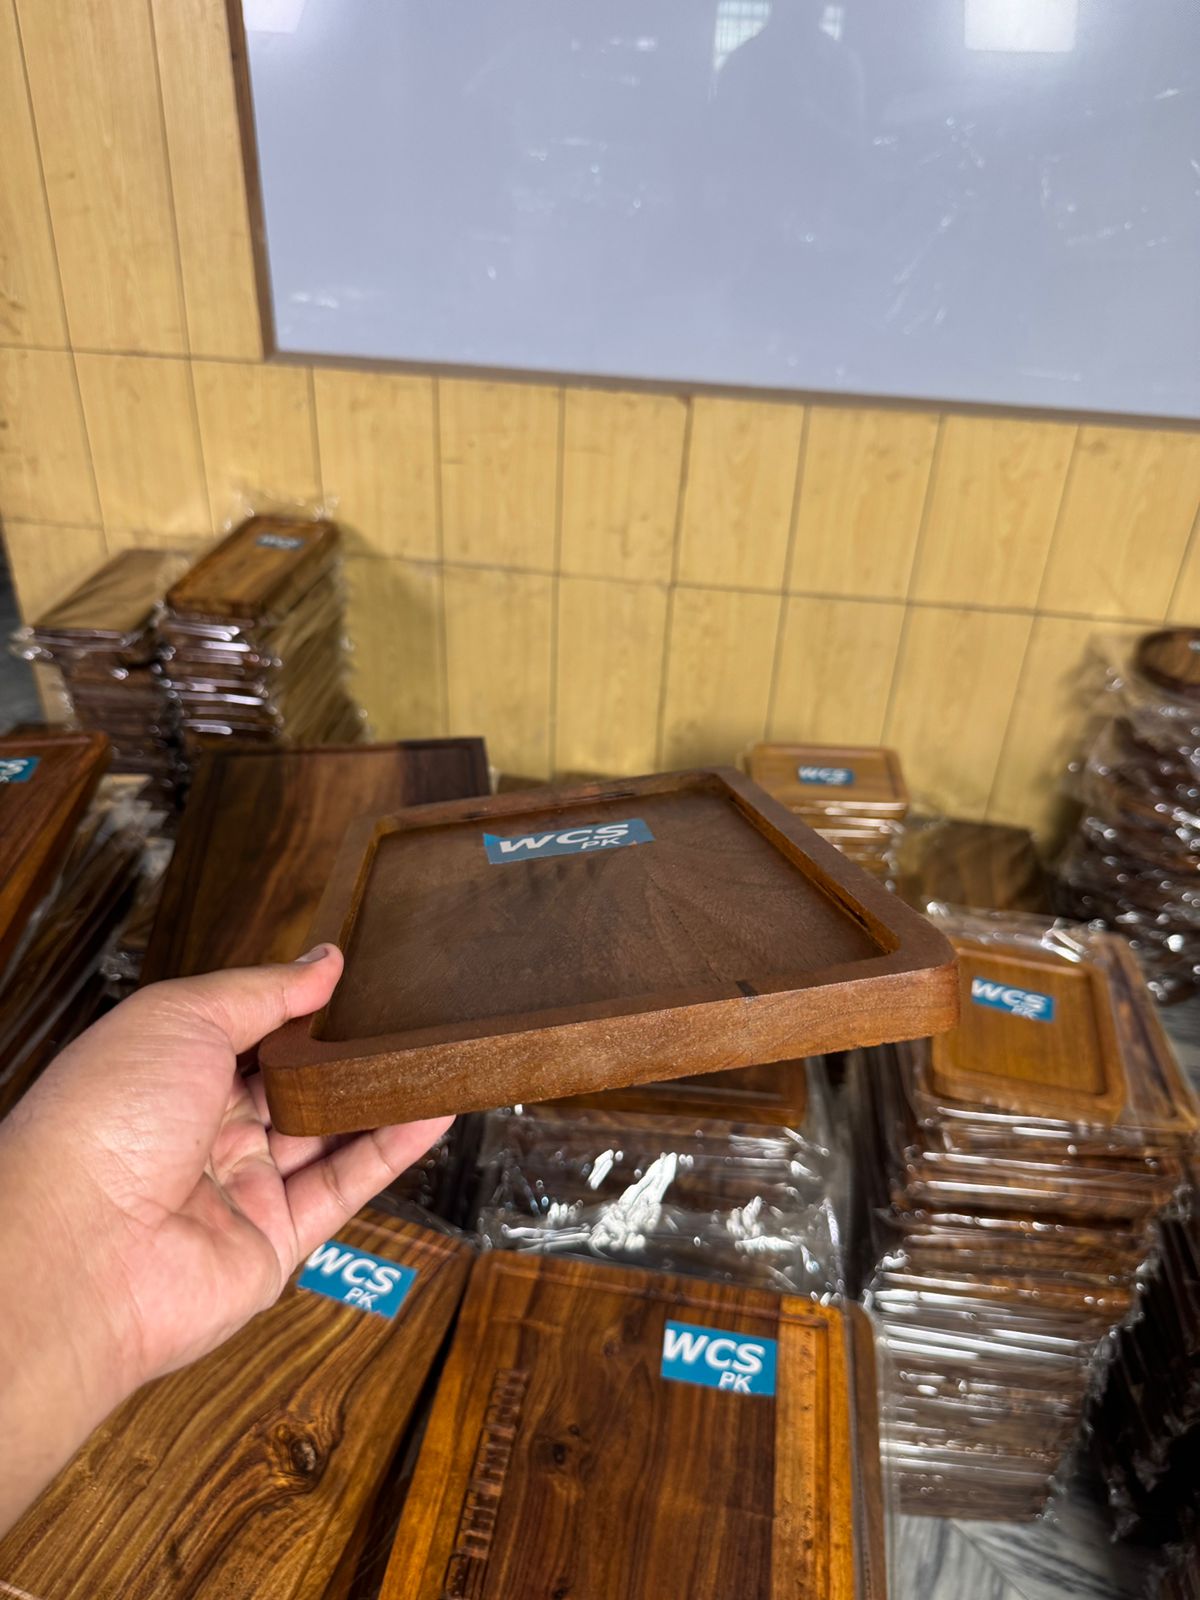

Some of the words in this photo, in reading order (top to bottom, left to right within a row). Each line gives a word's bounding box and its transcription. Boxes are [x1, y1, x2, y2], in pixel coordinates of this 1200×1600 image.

[500, 824, 629, 853] WCS
[580, 838, 621, 850] PK
[971, 979, 1047, 1013] WCS
[305, 1243, 402, 1295] WCS
[343, 1286, 378, 1311] PK
[663, 1328, 766, 1375] WCS
[718, 1371, 752, 1395] PK
